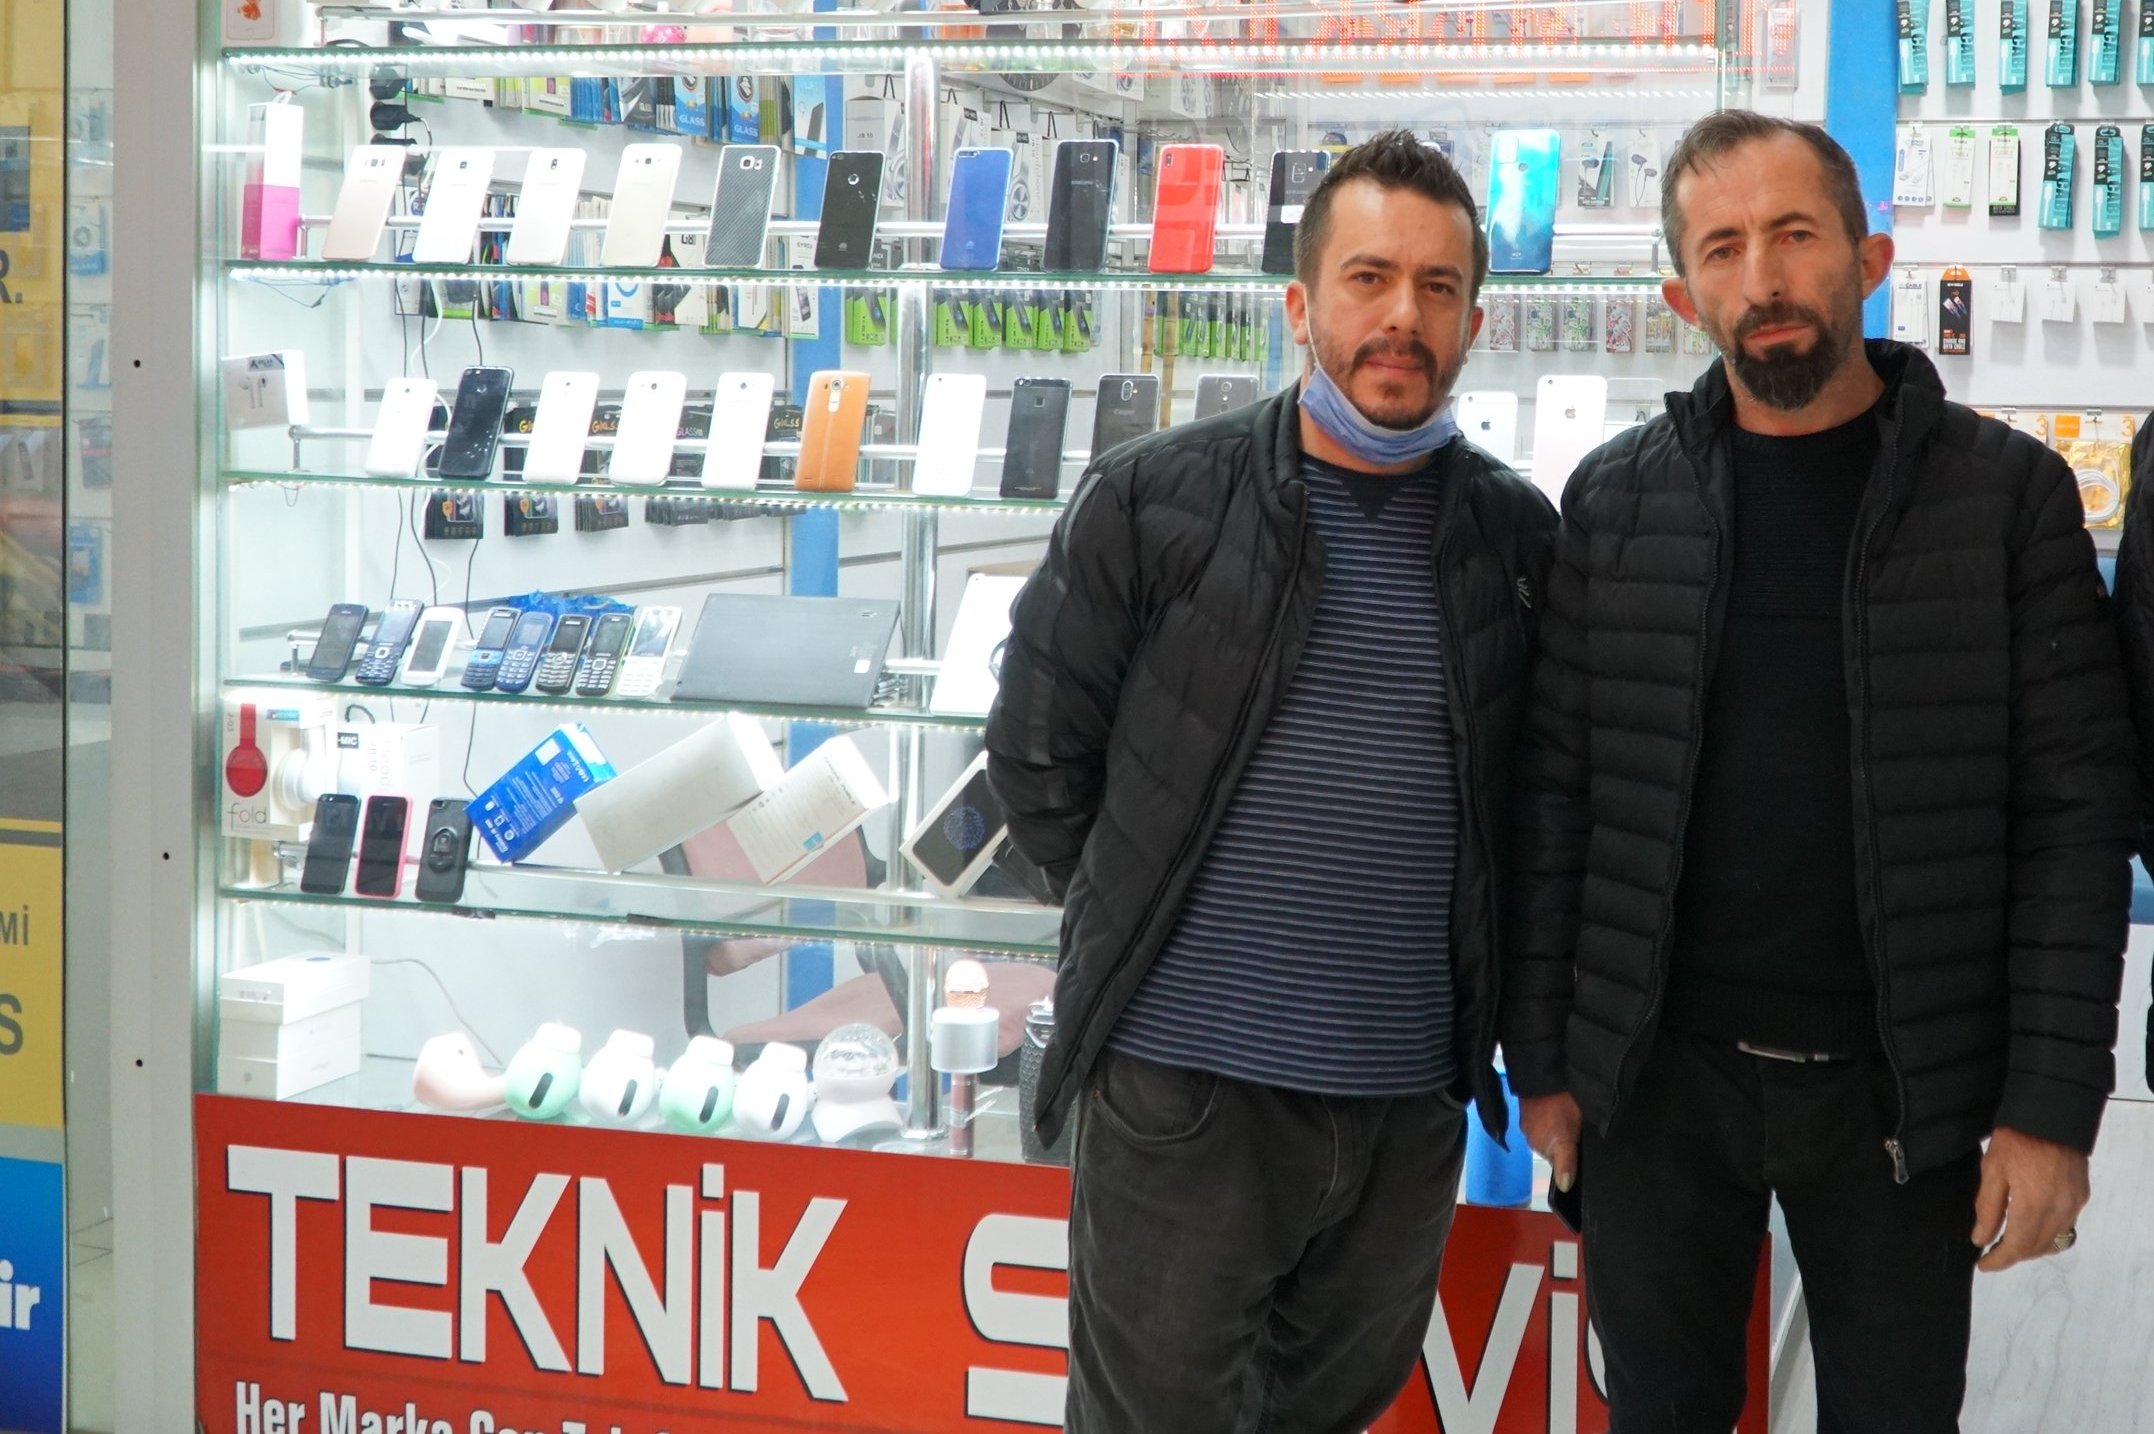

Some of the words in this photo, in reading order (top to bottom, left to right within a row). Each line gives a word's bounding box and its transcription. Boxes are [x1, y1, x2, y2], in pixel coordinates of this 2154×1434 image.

[679, 114, 705, 127] GLASS
[733, 124, 759, 136] GLASS
[227, 802, 267, 831] fold
